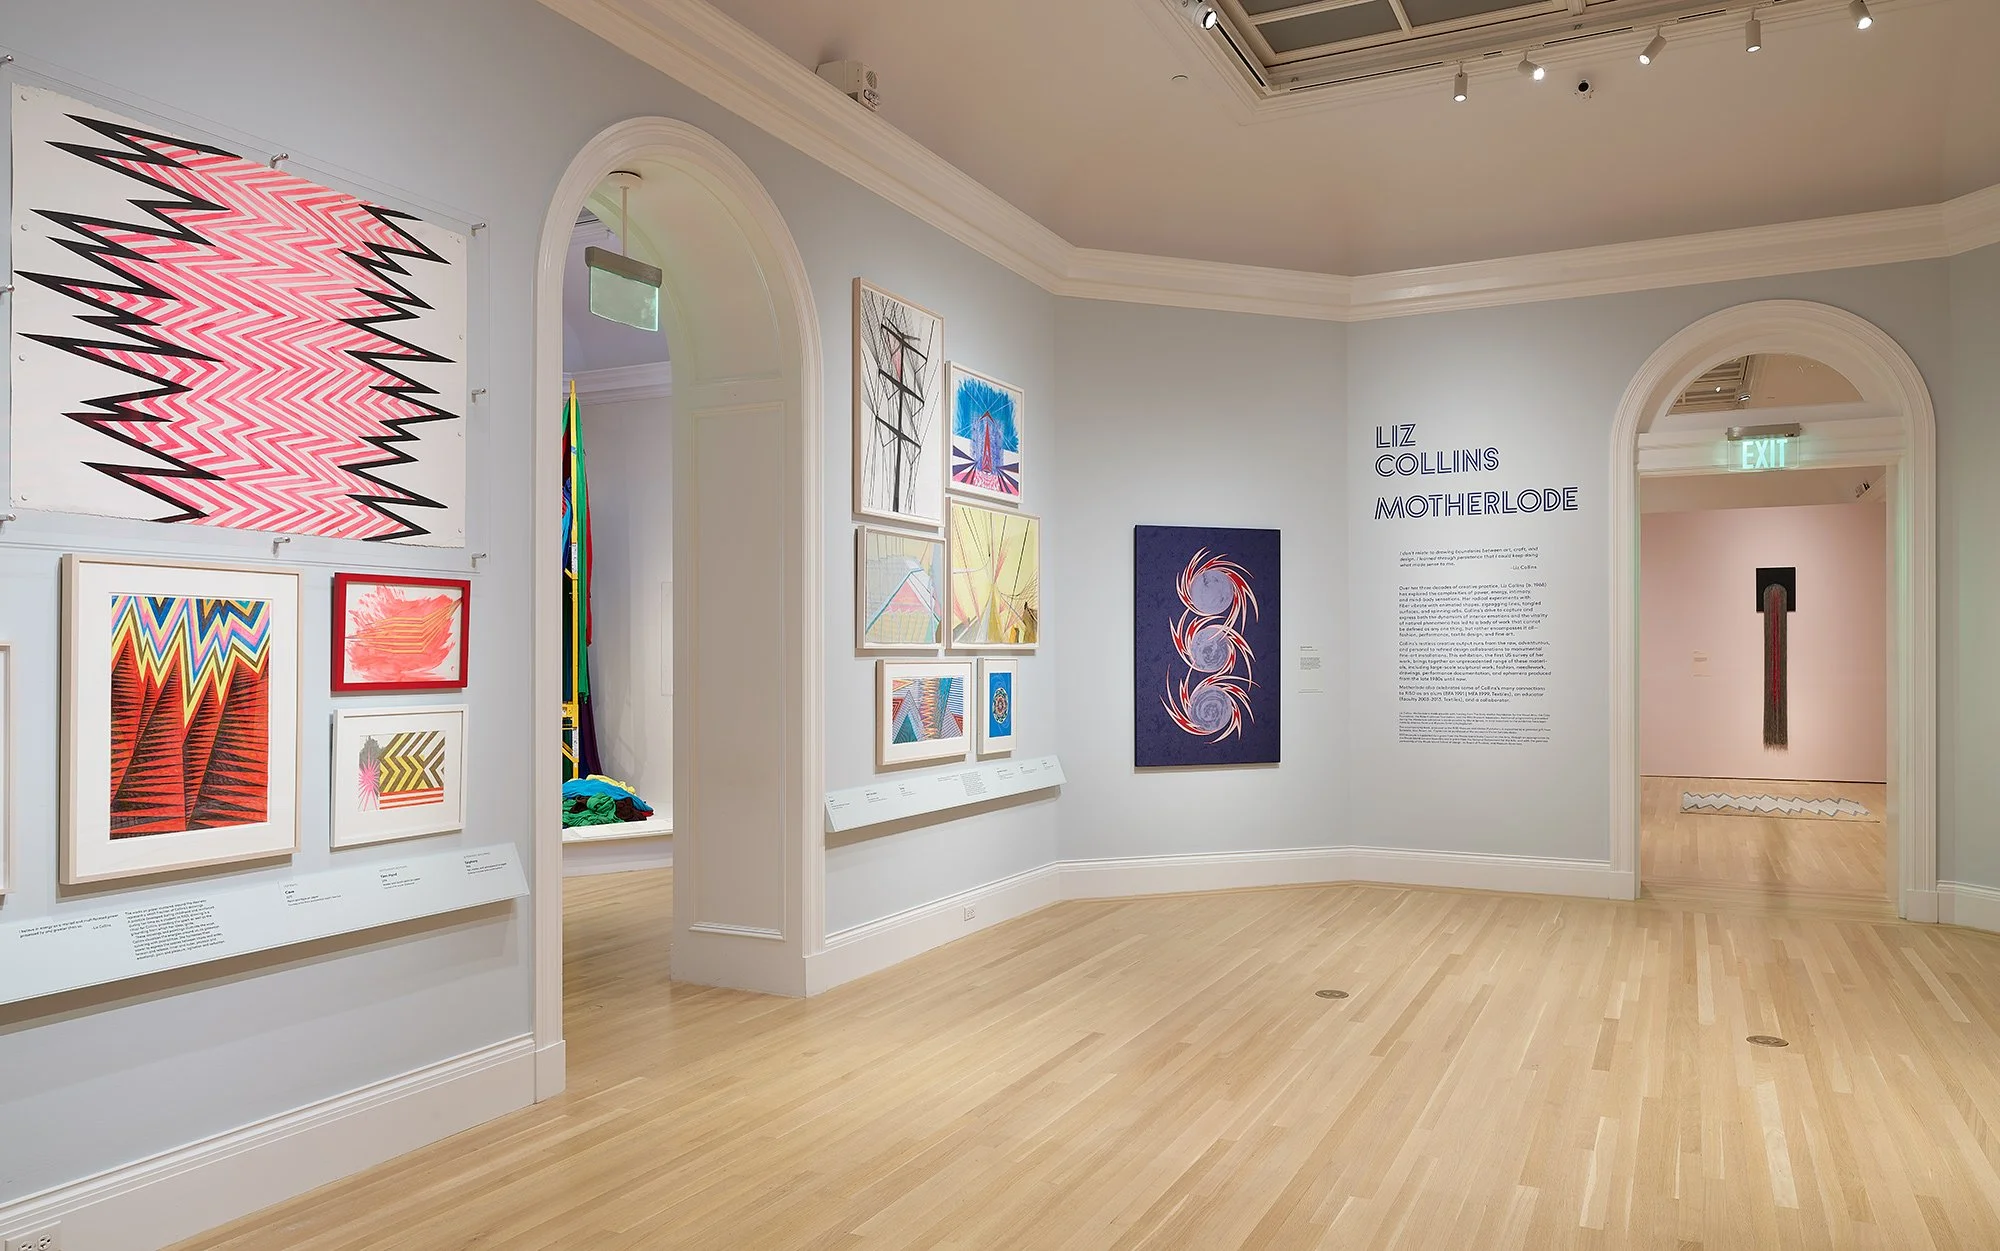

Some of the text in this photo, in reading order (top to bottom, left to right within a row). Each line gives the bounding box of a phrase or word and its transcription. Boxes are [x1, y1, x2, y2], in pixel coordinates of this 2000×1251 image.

[1376, 424, 1416, 448] LIZ
[1375, 447, 1499, 477] COLLINS
[1742, 439, 1788, 469] EXIT
[1375, 486, 1578, 519] MOTHERLODE
